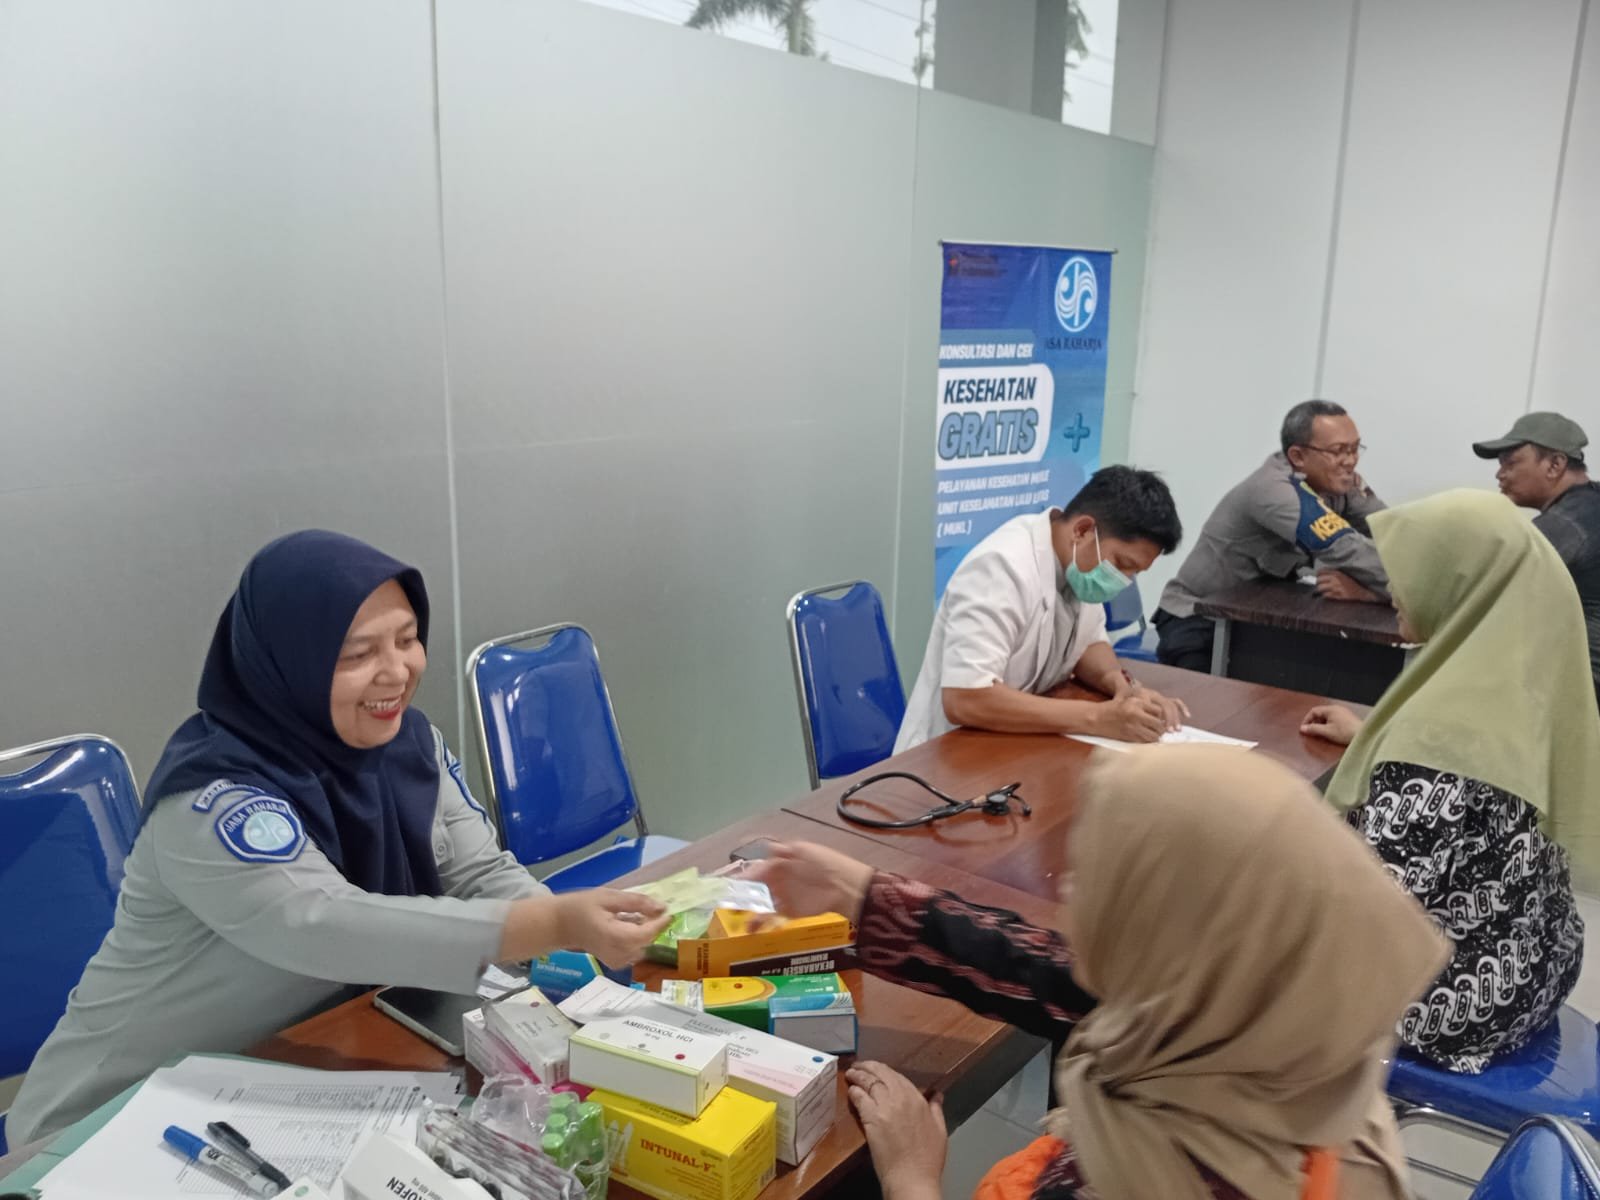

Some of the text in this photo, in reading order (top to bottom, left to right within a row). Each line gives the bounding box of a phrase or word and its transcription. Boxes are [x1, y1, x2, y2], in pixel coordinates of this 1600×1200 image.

[939, 343, 1034, 359] KONSULTASI DAN CEK
[944, 377, 1037, 404] KESEHATAN
[938, 408, 1039, 461] GRATIS
[938, 477, 986, 493] PELAYANAN
[987, 472, 1030, 489] KESEHATAN
[938, 501, 959, 515] UNIT
[959, 495, 1015, 513] KESELAMATAN
[223, 811, 247, 833] JASA
[622, 1019, 675, 1039] AMBROXOL
